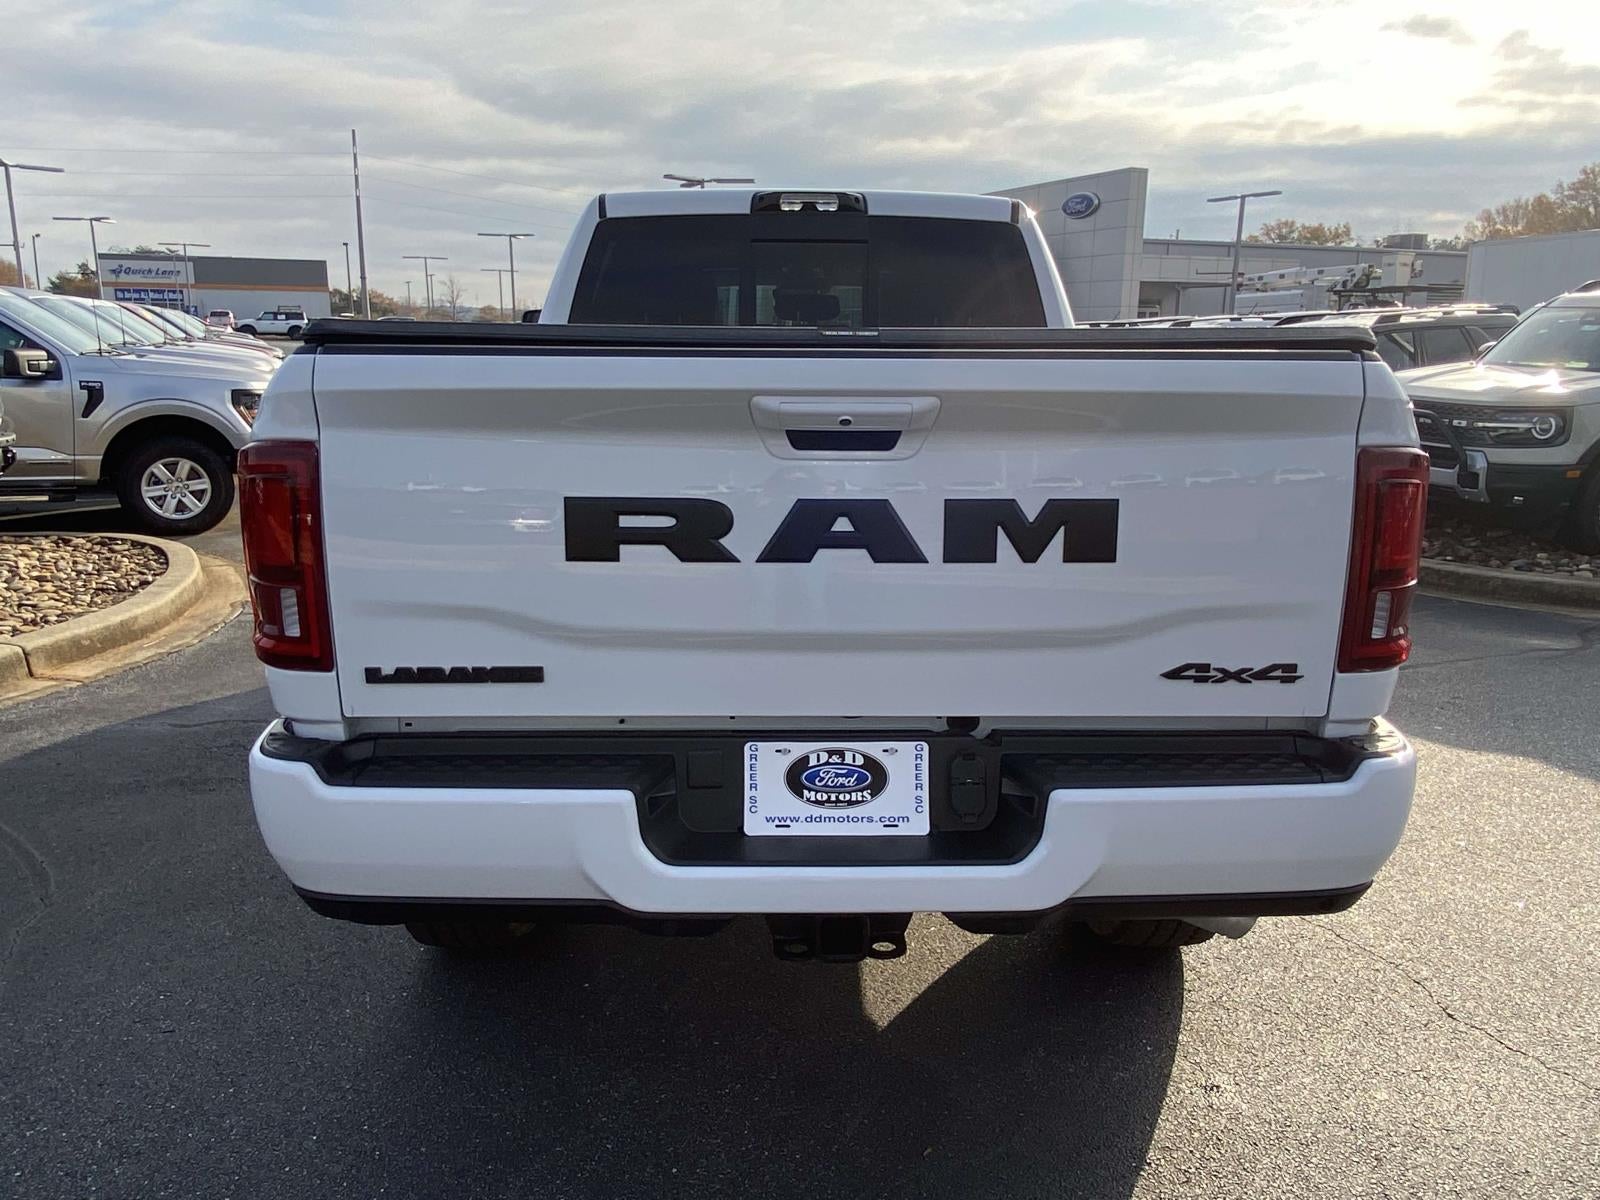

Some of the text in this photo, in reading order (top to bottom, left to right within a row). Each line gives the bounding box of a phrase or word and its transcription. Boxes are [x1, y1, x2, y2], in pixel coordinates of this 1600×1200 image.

[123, 266, 154, 276] Quick
[563, 496, 1120, 564] RAM
[1160, 663, 1304, 683] 4x4
[807, 750, 865, 767] D&D
[749, 743, 758, 814] GREER SC
[815, 768, 858, 787] Ford
[914, 743, 924, 814] GREER SC
[802, 789, 872, 801] MOTORS
[765, 814, 910, 823] www.ddmotors.com
